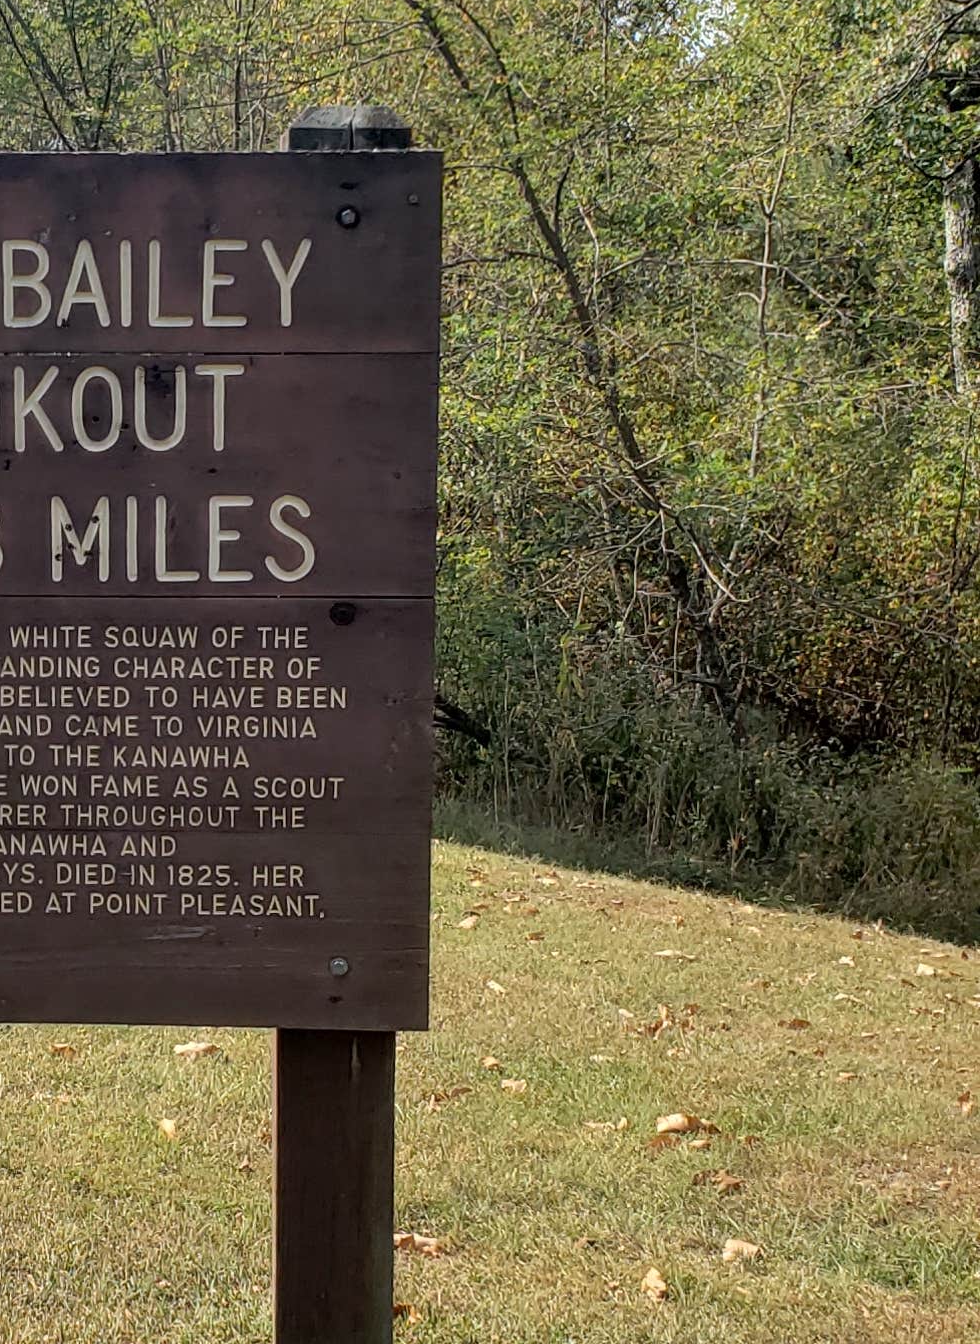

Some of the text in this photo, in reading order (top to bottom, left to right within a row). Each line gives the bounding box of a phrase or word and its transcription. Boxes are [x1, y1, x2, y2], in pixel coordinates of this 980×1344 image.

[3, 239, 312, 328] BAILEY
[51, 495, 316, 583] MILES
[10, 626, 92, 648] WHITE
[104, 626, 198, 648] SQUAW
[212, 626, 244, 648] OF
[257, 627, 308, 649] THE
[114, 657, 274, 679] CHARACTER
[287, 657, 320, 679] OF
[0, 686, 130, 707] BELIEVED
[144, 687, 178, 708] TO
[193, 687, 264, 708] HAVE
[277, 687, 346, 709] BEEN
[65, 716, 139, 737] CAME
[152, 716, 182, 737] TO
[197, 716, 317, 738] VIRGINIA
[4, 745, 34, 766] TO
[48, 745, 100, 767] THE
[114, 745, 249, 768] KANAWHA
[21, 775, 77, 796] WON
[90, 775, 159, 797] FAME
[173, 776, 208, 798] AS
[222, 776, 239, 798] A
[254, 777, 344, 799] SCOUT
[61, 805, 240, 827] THROUGHOUT
[254, 807, 305, 828] THE
[120, 835, 176, 857] AND
[56, 863, 116, 885] DIED
[130, 865, 155, 885] IN
[169, 865, 239, 886] 1825.
[253, 866, 303, 887] HER
[45, 893, 76, 914] AT
[90, 893, 167, 915] POINT
